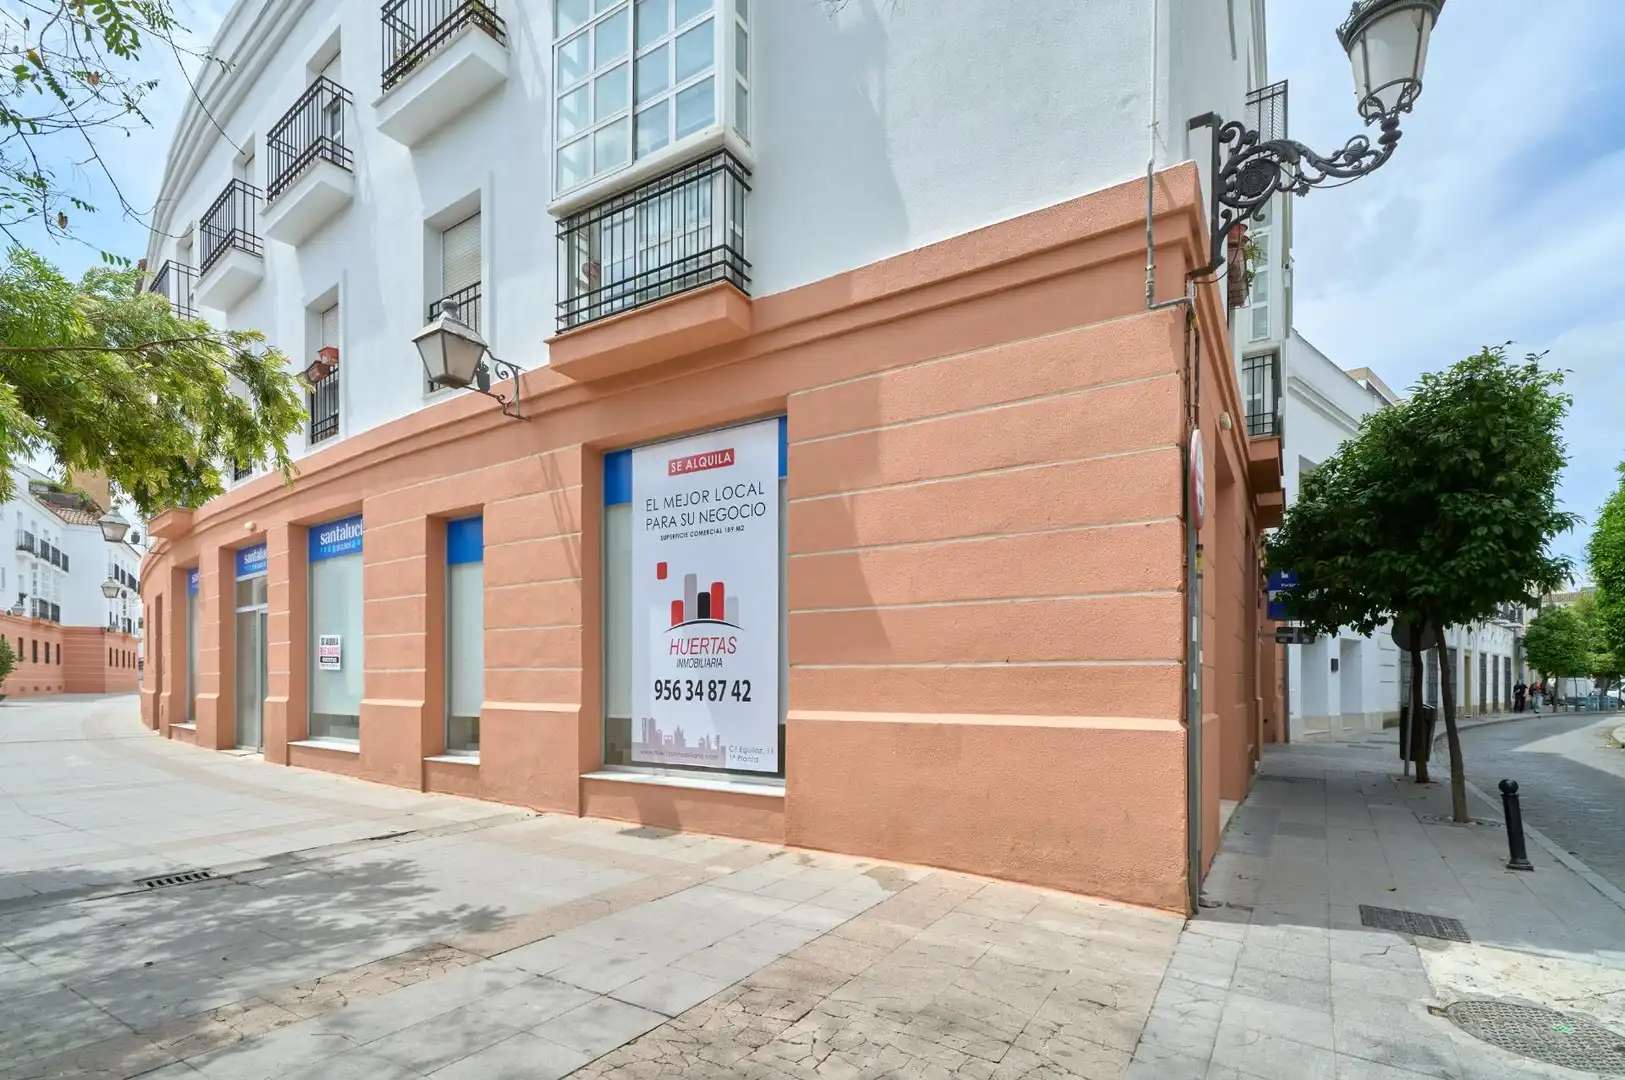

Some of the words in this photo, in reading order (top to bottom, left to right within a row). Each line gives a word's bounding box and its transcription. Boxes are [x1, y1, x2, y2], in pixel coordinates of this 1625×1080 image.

[671, 460, 682, 473] SE
[685, 452, 732, 470] ALQUILA
[646, 498, 659, 512] EL
[664, 490, 710, 509] MEJOR
[715, 481, 765, 502] LOCAL
[646, 514, 677, 531] PARA
[681, 512, 695, 527] SU
[699, 501, 766, 523] NEGOCIO
[660, 532, 688, 541] SUPERFICIE
[690, 528, 722, 538] COMERCIAL
[669, 636, 737, 656] HUERTAS
[676, 657, 723, 669] INMOBILIARIA
[654, 679, 682, 701] 956
[685, 679, 704, 702] 34
[708, 679, 727, 702] 87
[731, 679, 751, 703] 42
[737, 755, 759, 763] Planta
